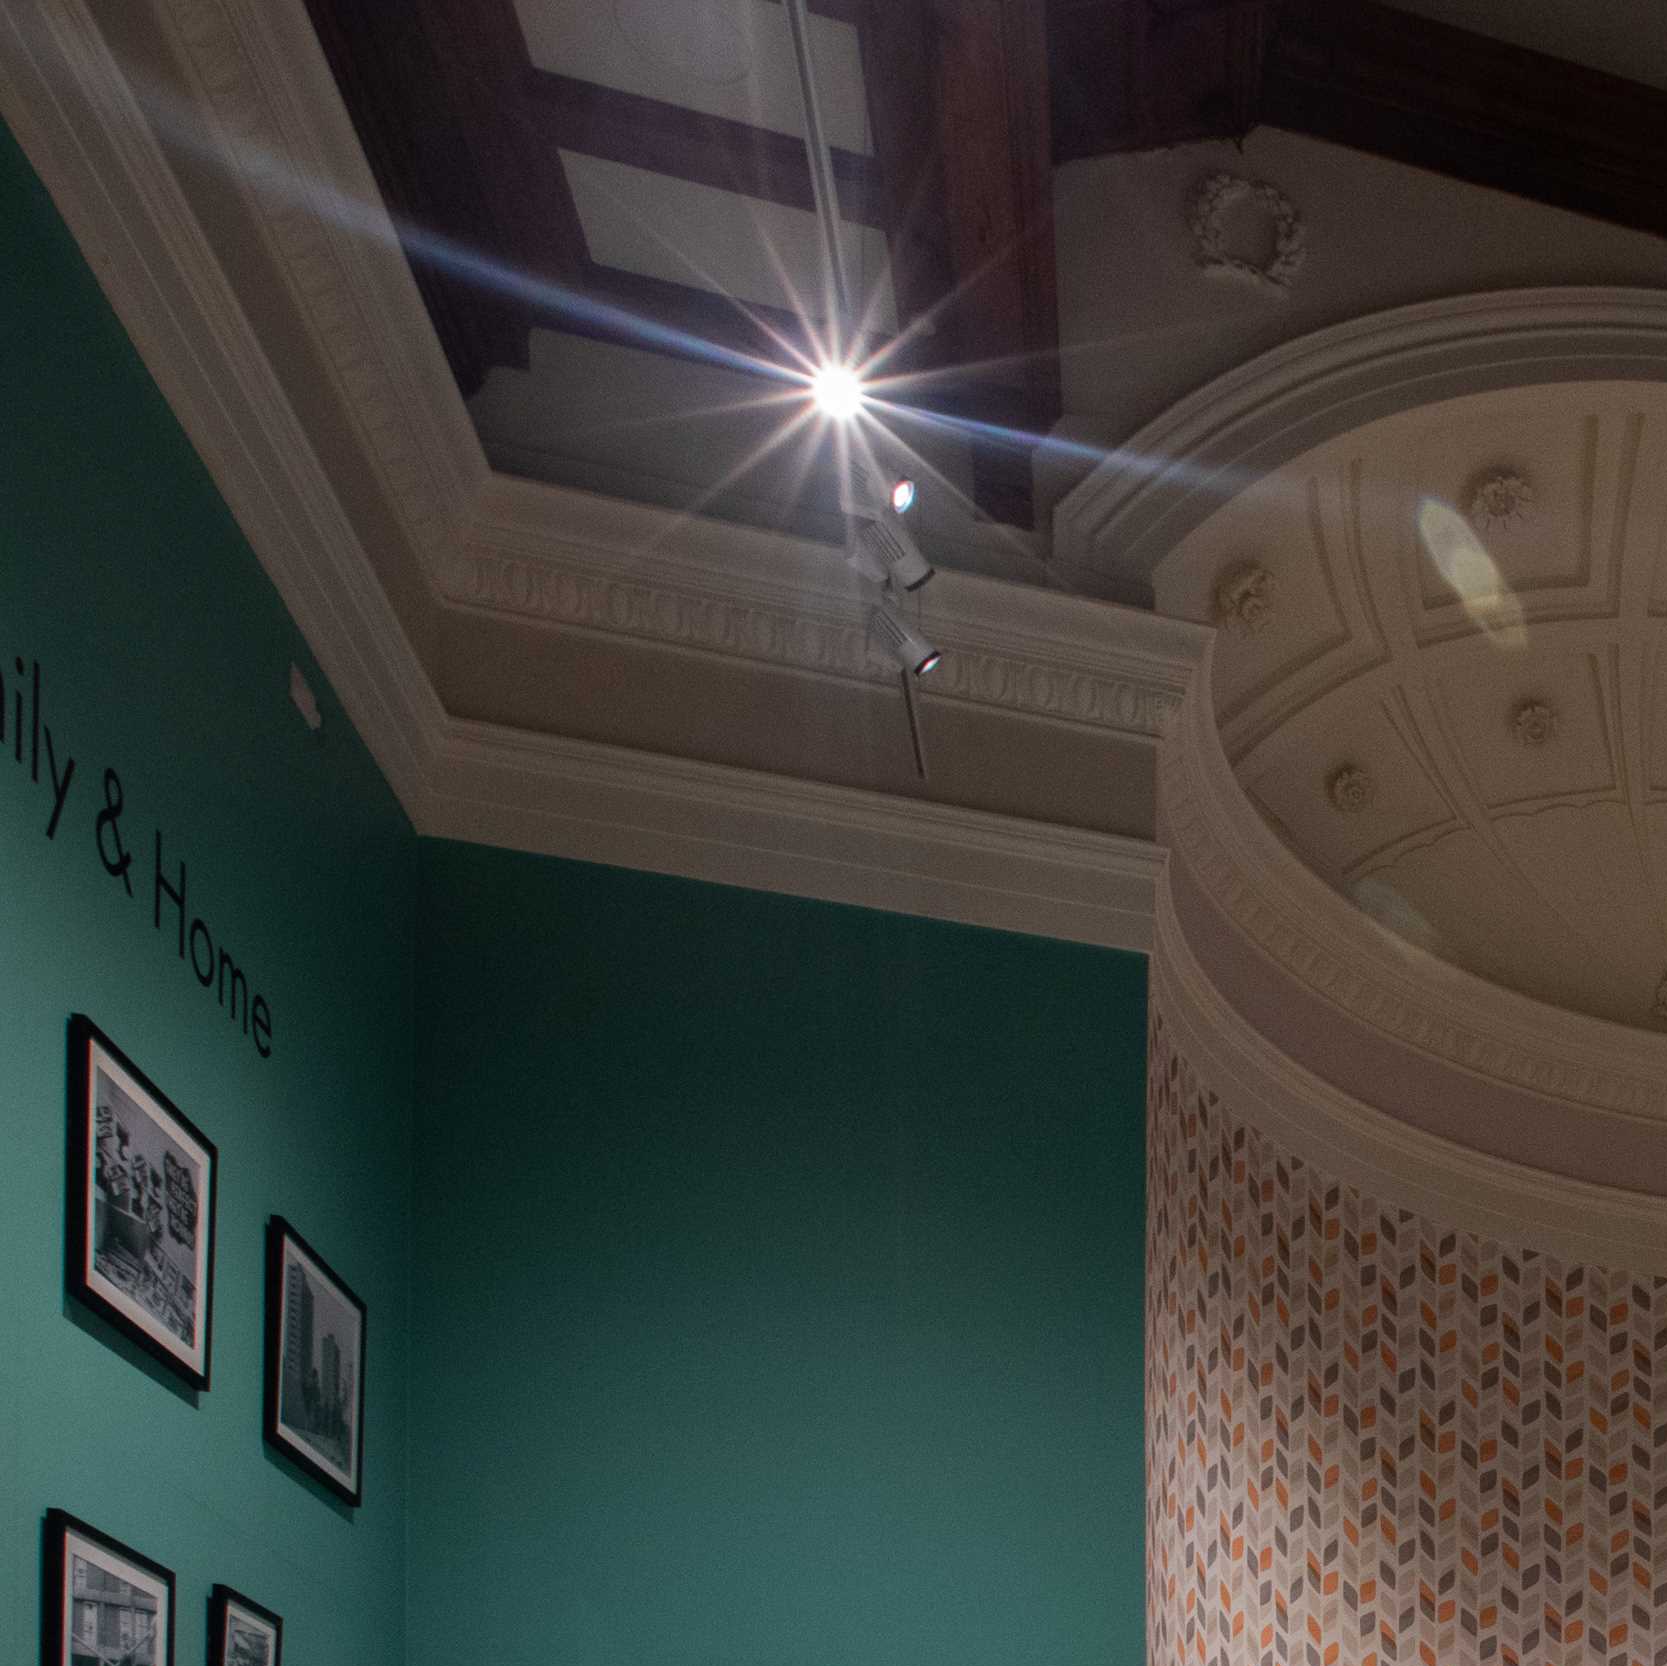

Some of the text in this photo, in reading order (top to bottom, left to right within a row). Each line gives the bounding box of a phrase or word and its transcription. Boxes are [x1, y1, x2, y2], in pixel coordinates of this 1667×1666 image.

[0, 656, 273, 1058] ily & Home
